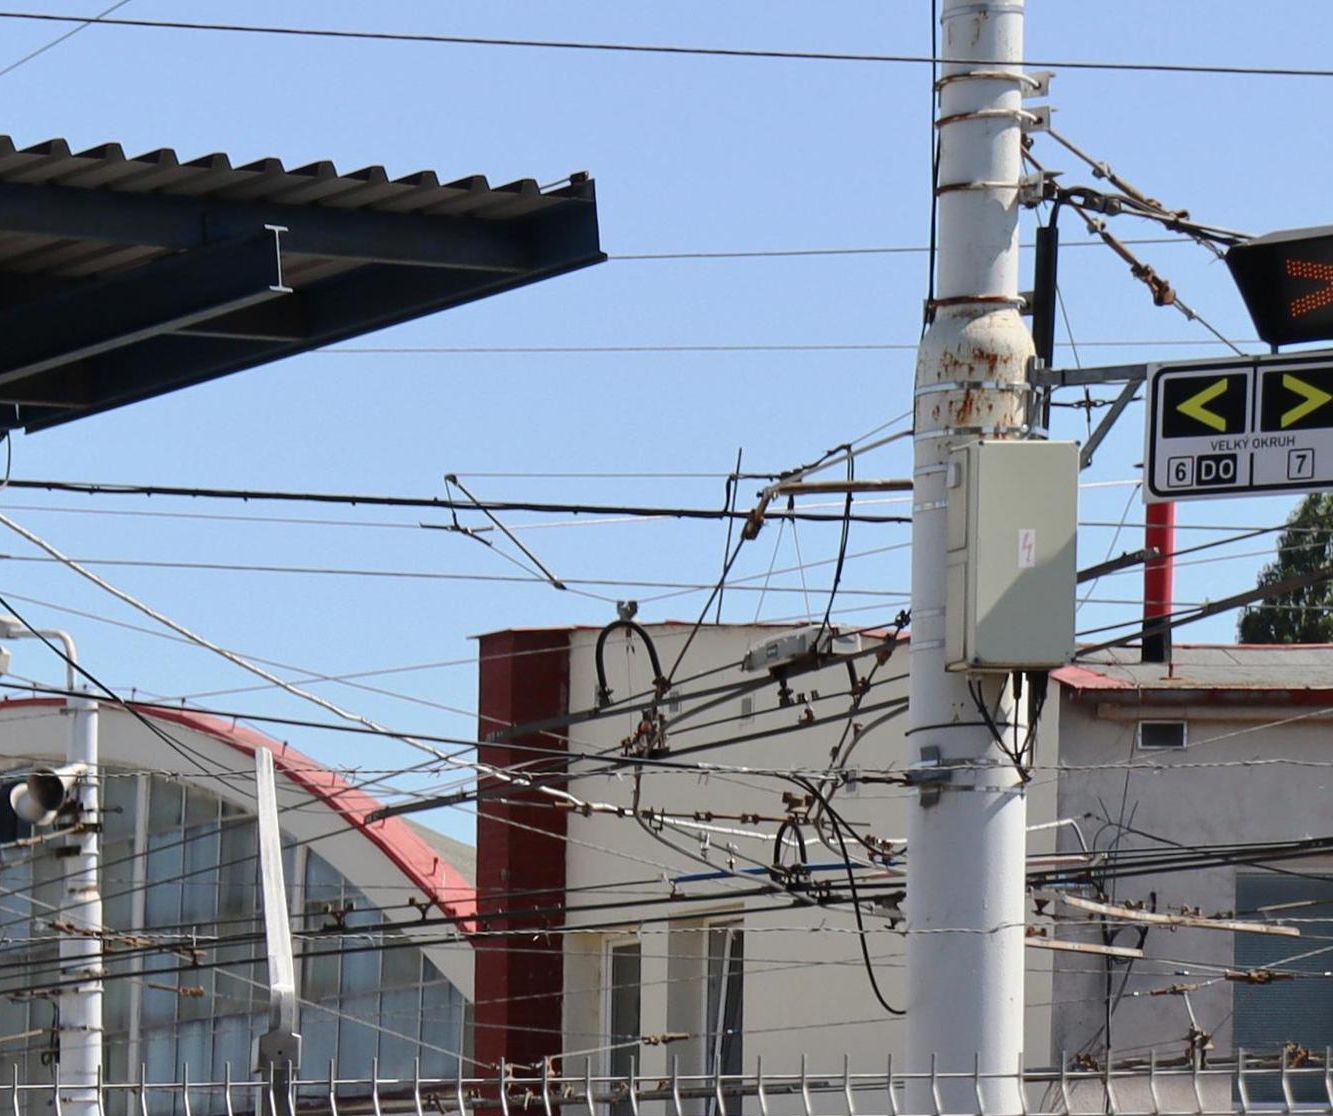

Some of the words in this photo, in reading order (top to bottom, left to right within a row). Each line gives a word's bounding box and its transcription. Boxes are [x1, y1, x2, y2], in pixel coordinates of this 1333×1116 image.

[1211, 437, 1248, 451] VELKÝ
[1252, 436, 1295, 449] OKRUH
[1175, 463, 1186, 481] 6
[1201, 459, 1233, 480] DO
[1296, 454, 1306, 474] 7
